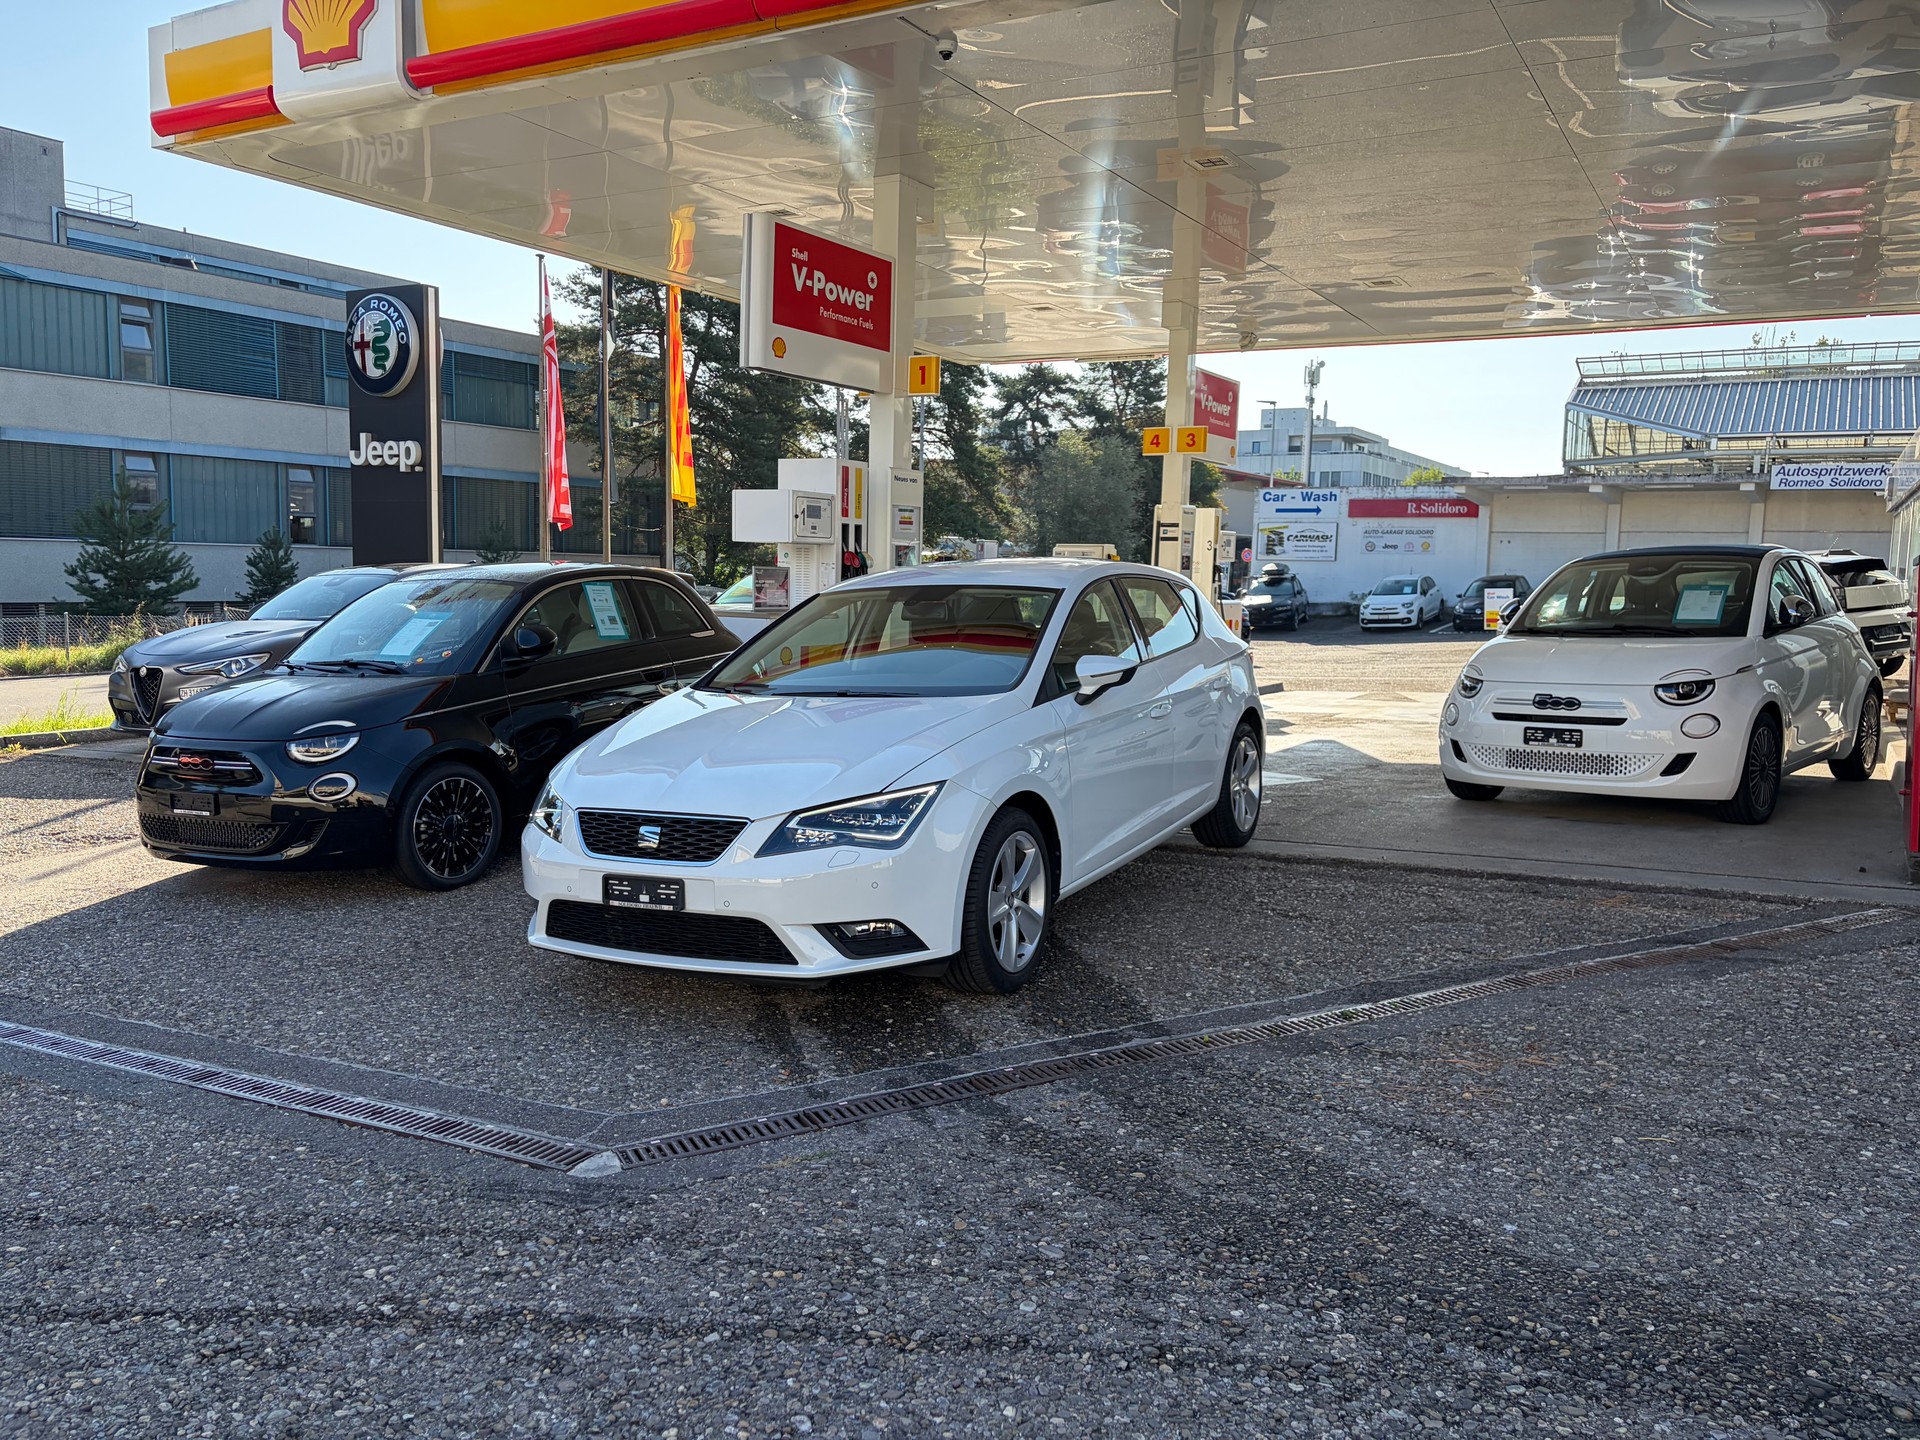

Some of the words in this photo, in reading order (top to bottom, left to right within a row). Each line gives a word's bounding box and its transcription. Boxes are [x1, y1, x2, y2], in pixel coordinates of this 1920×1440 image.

[791, 248, 809, 262] Shell
[791, 263, 874, 311] V-Power
[347, 306, 366, 347] ALFA
[370, 299, 407, 345] ROMEO
[819, 306, 858, 326] Performance
[858, 319, 874, 330] Fuels
[919, 365, 926, 385] 1
[1200, 393, 1231, 417] V-Power
[1150, 434, 1161, 448] 4
[1186, 432, 1196, 447] 3
[349, 432, 422, 472] Jeep
[894, 474, 909, 483] Neues
[1775, 465, 1889, 478] Autospritzwerk
[1778, 478, 1824, 487] Romeo
[1829, 477, 1883, 487] Solidoro
[1262, 491, 1287, 502] Car
[1300, 491, 1338, 502] Wash
[801, 508, 806, 526] 1
[1206, 540, 1213, 552] 3
